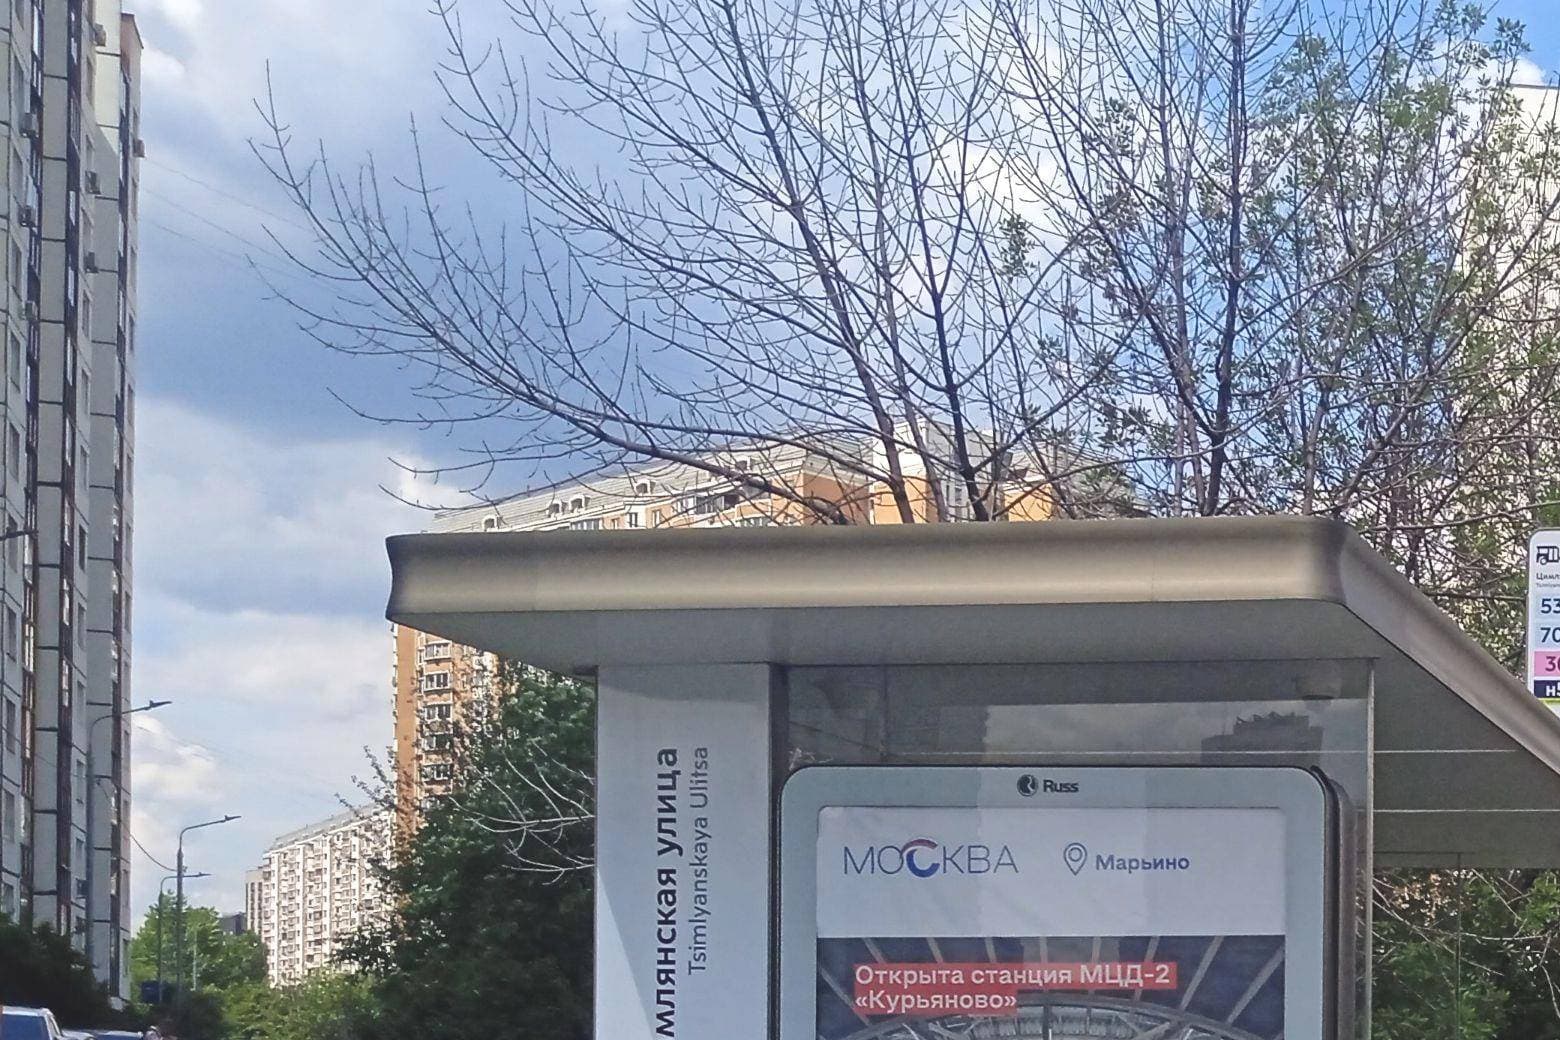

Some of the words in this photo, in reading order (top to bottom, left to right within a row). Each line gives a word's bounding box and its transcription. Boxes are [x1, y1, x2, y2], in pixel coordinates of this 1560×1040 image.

[688, 746, 709, 809] Ulitsa
[1042, 779, 1080, 794] Russ
[656, 747, 684, 857] улица
[843, 838, 1020, 878] МОСКВА
[1095, 853, 1190, 874] Марьино
[687, 816, 712, 976] Tsimlyanskaya
[855, 964, 965, 989] Открыта
[971, 967, 1073, 985] станция
[1078, 964, 1170, 988] МЦД-2
[854, 990, 1018, 1012] «Курьяново»
